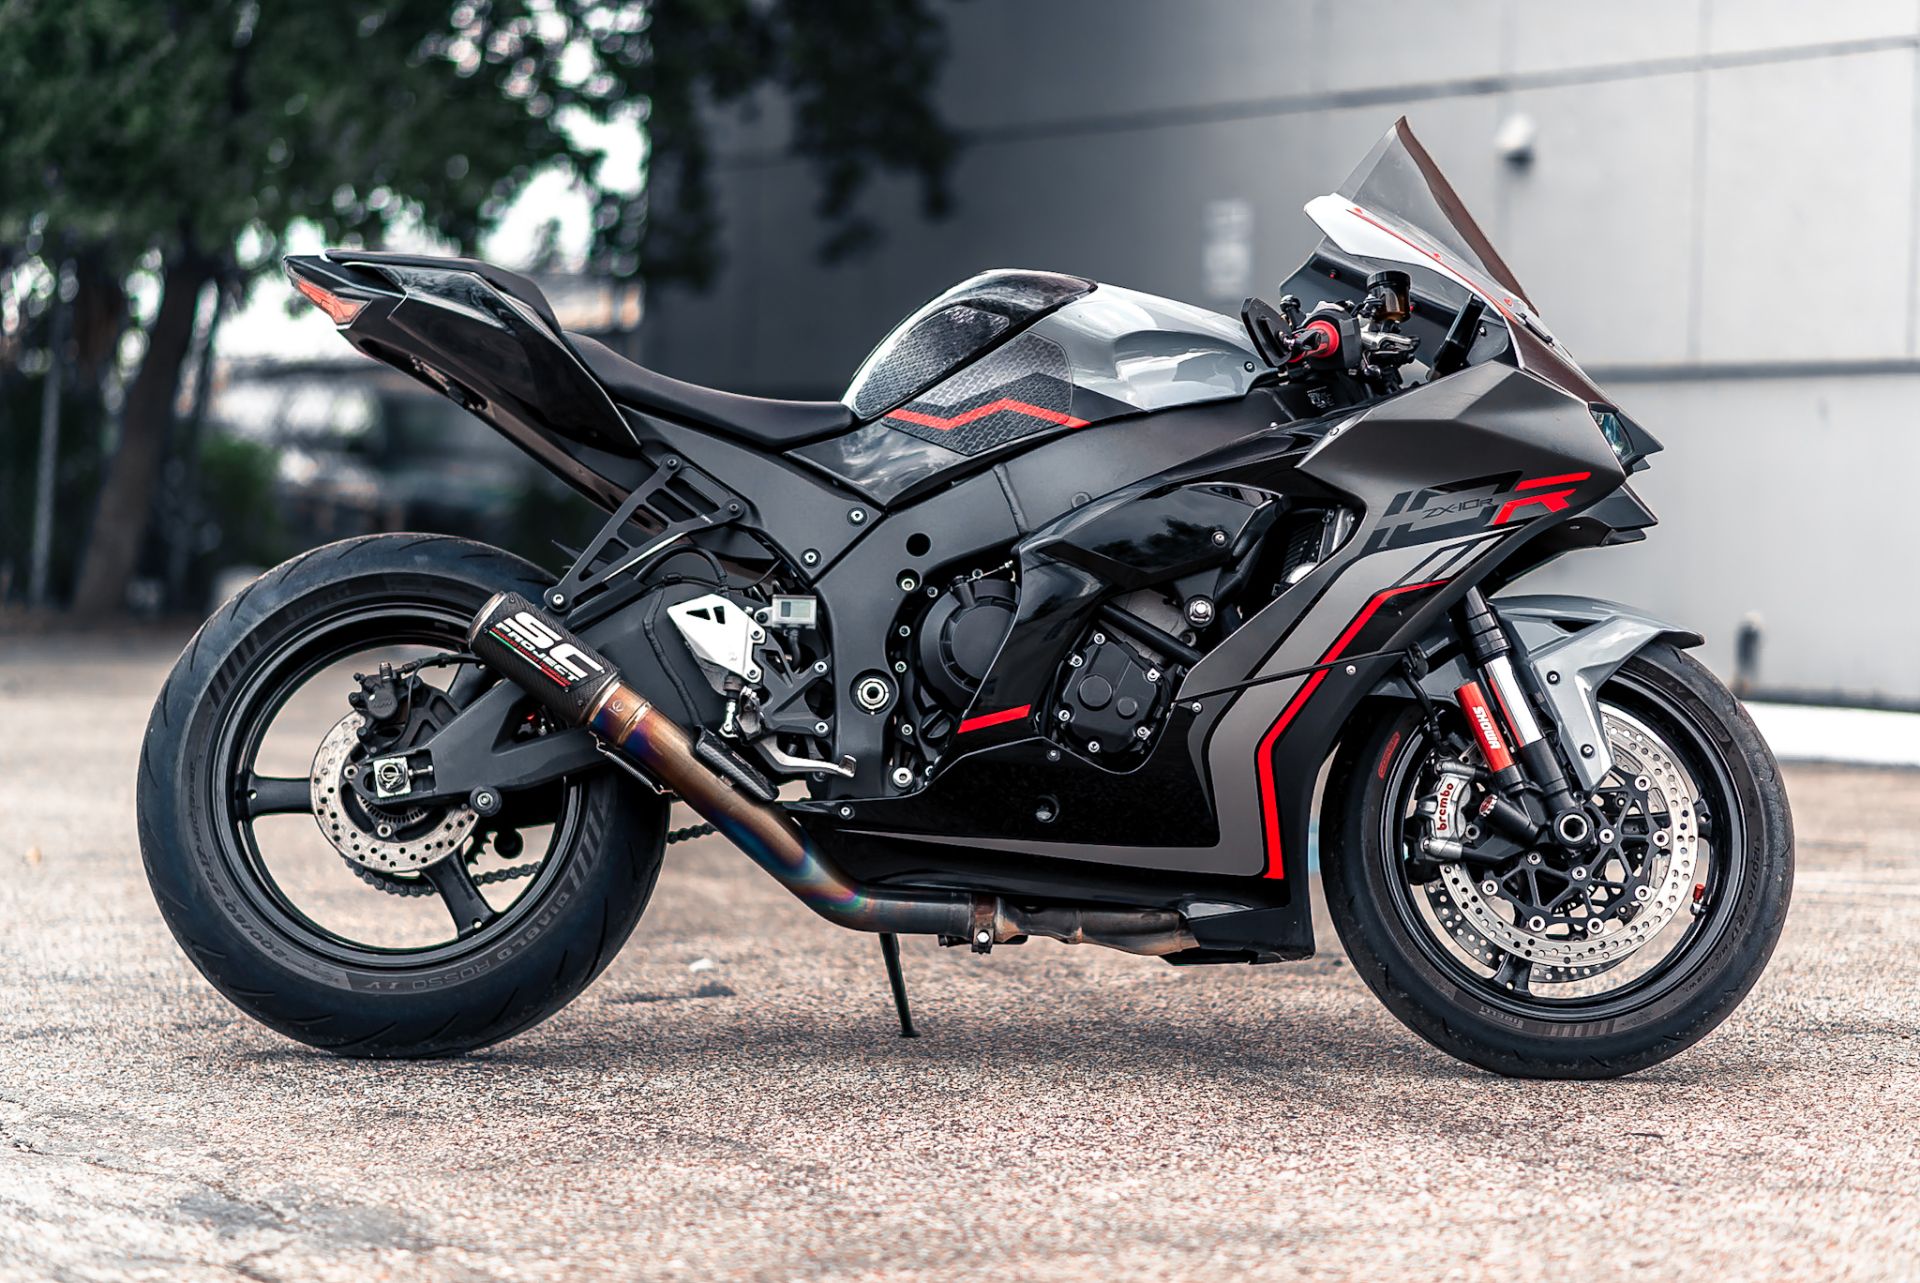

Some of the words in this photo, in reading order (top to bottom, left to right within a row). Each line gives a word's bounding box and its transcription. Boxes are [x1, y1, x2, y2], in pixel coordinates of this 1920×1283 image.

[1422, 498, 1494, 520] ZX-10R
[495, 622, 581, 681] PROJECT
[503, 611, 604, 679] SC
[1472, 706, 1501, 750] SHOWA
[1436, 782, 1454, 831] brembo
[497, 892, 570, 961] DIABLO
[412, 959, 492, 990] ROSSO
